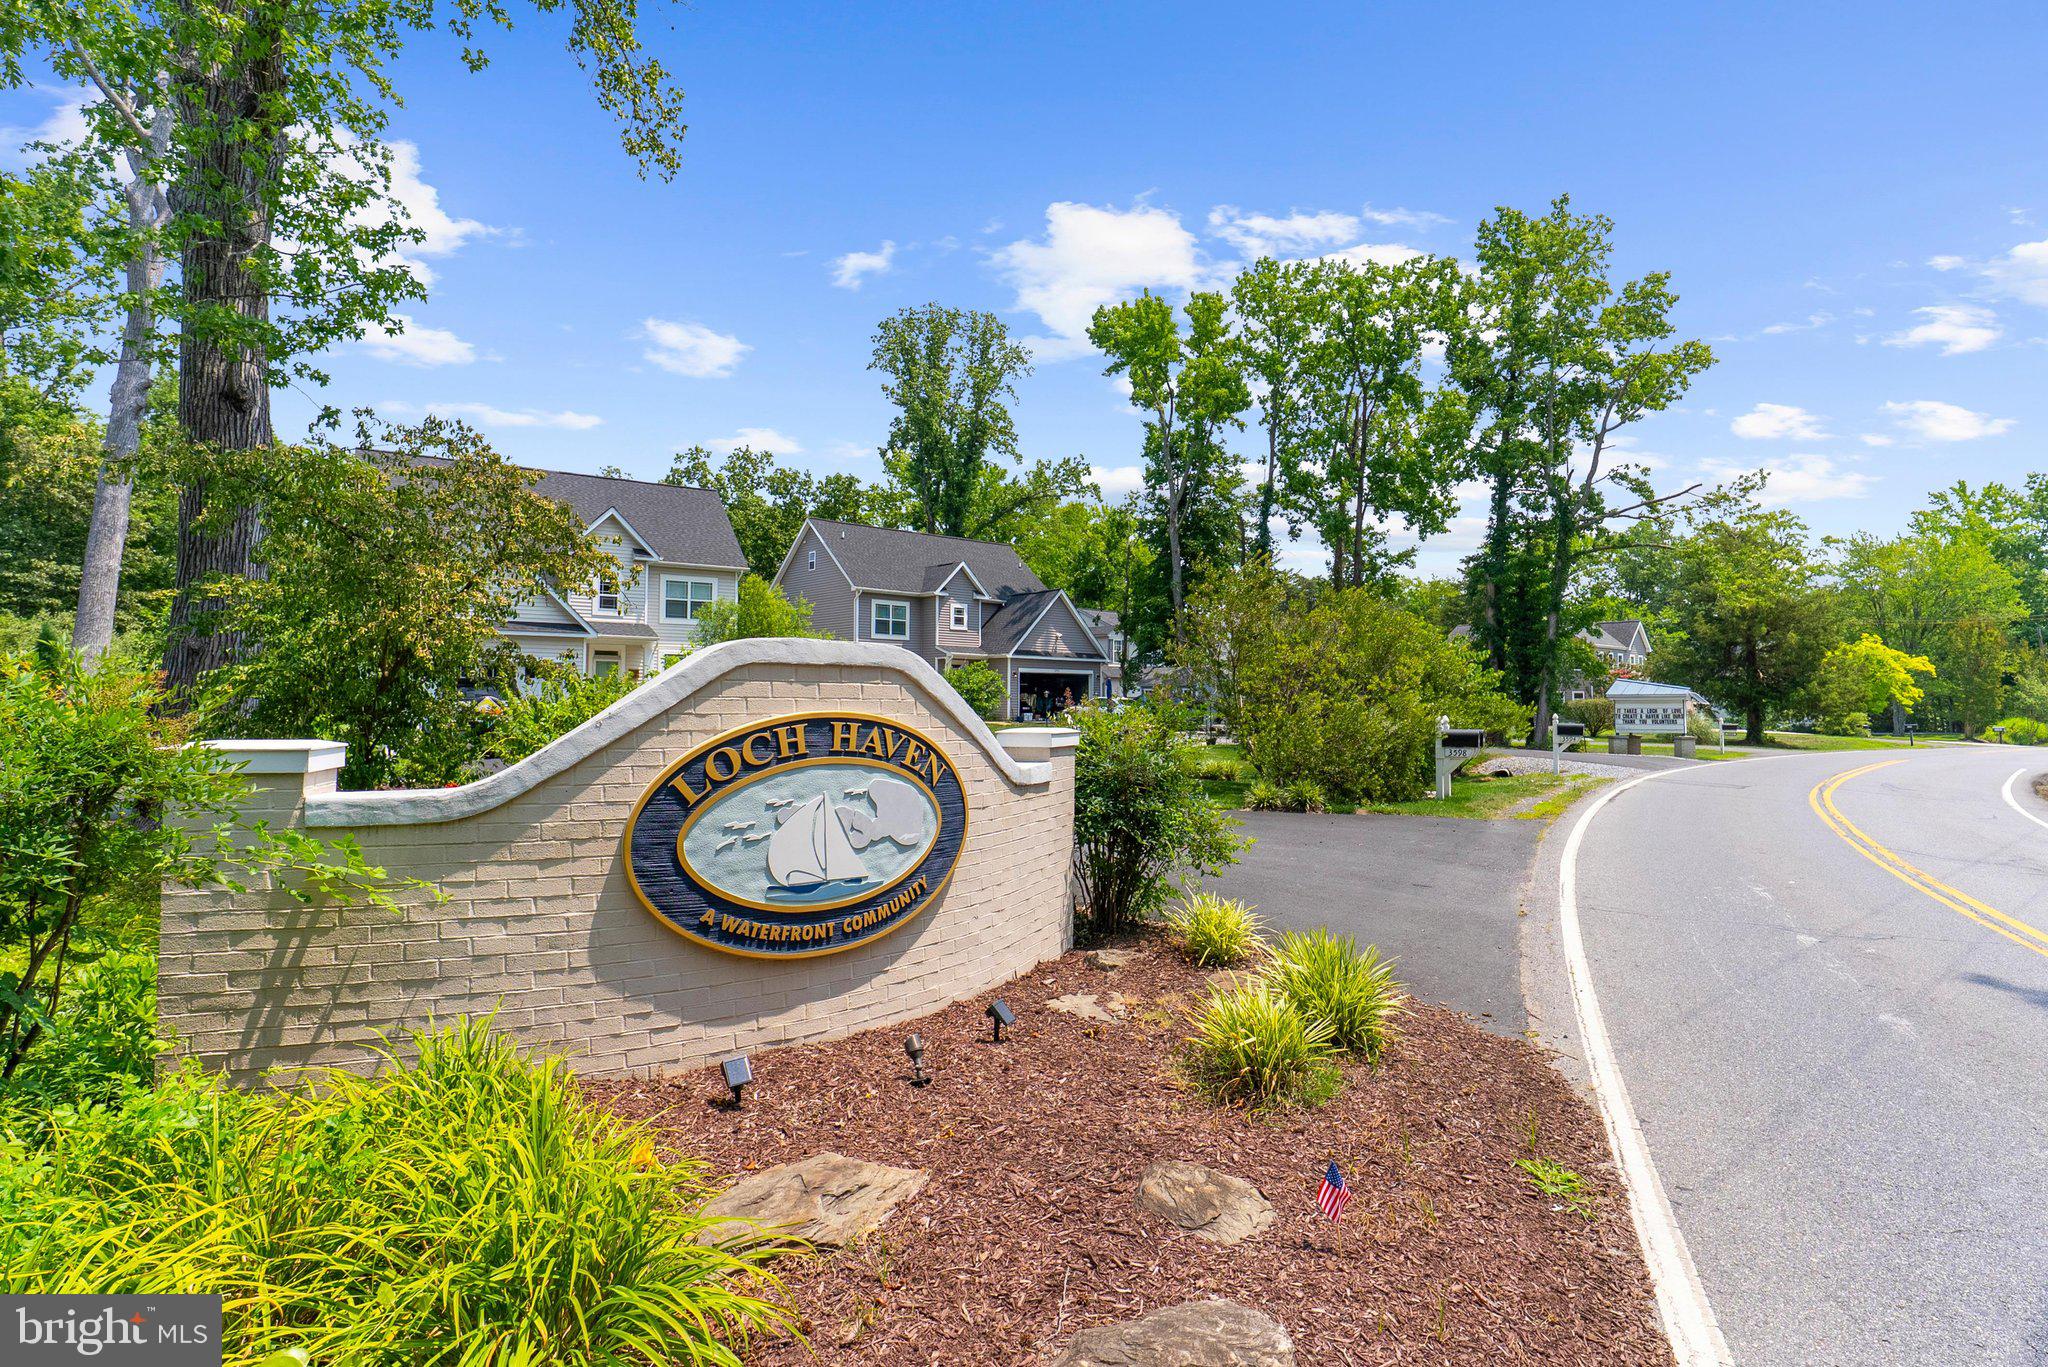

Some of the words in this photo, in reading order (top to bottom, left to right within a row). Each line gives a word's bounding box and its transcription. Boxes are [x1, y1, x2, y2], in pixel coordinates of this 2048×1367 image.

[668, 723, 809, 807] LOCH
[830, 721, 948, 788] HAVEN
[1448, 749, 1467, 757] 3598
[700, 909, 714, 926] A
[720, 915, 835, 941] WATERFRONT
[842, 876, 929, 934] COMMUNITY
